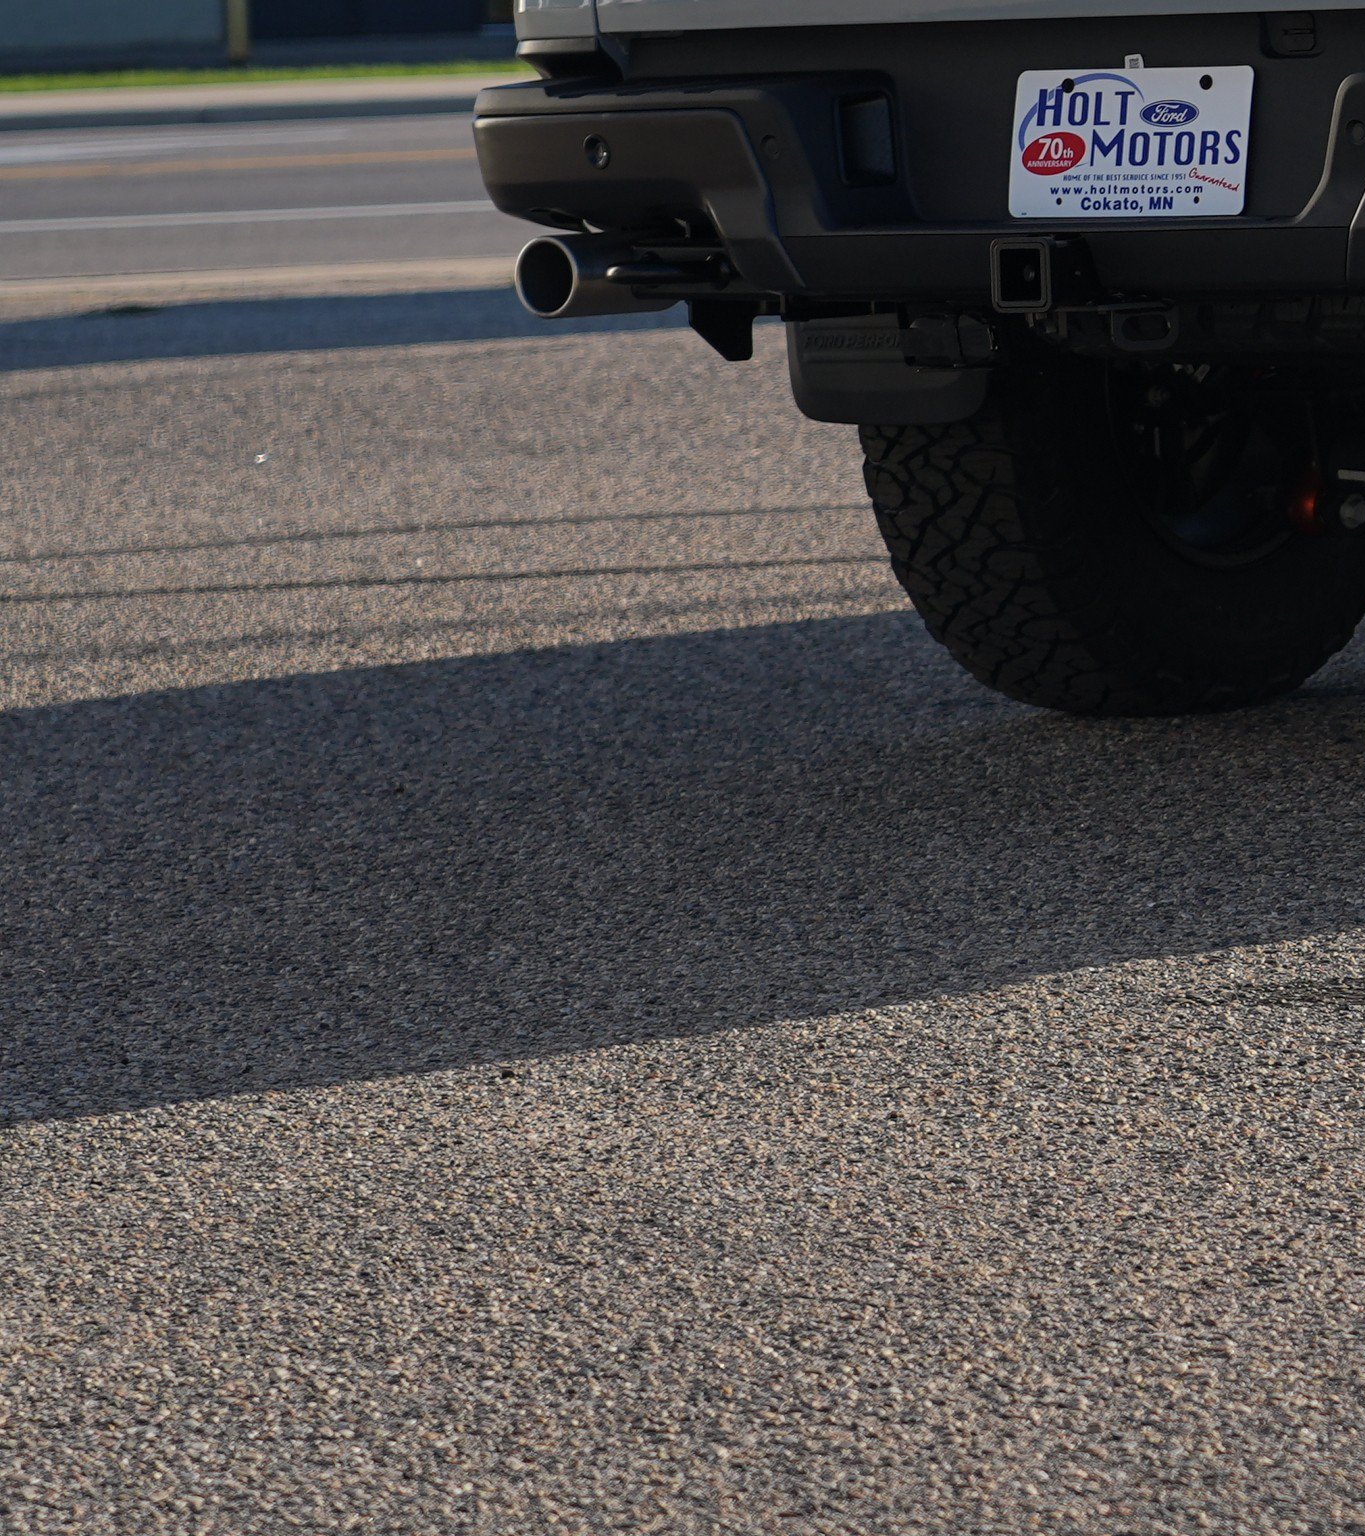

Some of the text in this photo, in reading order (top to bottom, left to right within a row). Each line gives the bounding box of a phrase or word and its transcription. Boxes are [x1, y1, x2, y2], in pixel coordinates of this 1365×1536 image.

[1036, 88, 1135, 127] HOLT
[1150, 103, 1188, 123] Ford
[1038, 137, 1074, 160] 70th
[1090, 129, 1242, 167] MOTORS
[1027, 159, 1073, 168] ANNIVERSARY
[1063, 173, 1187, 182] HOME OF THE BEST SERVICE SINCE 1951
[1189, 167, 1241, 193] Guaranteed
[1050, 184, 1204, 196] www.holtmotors.com
[1081, 197, 1174, 213] Cokato, MN
